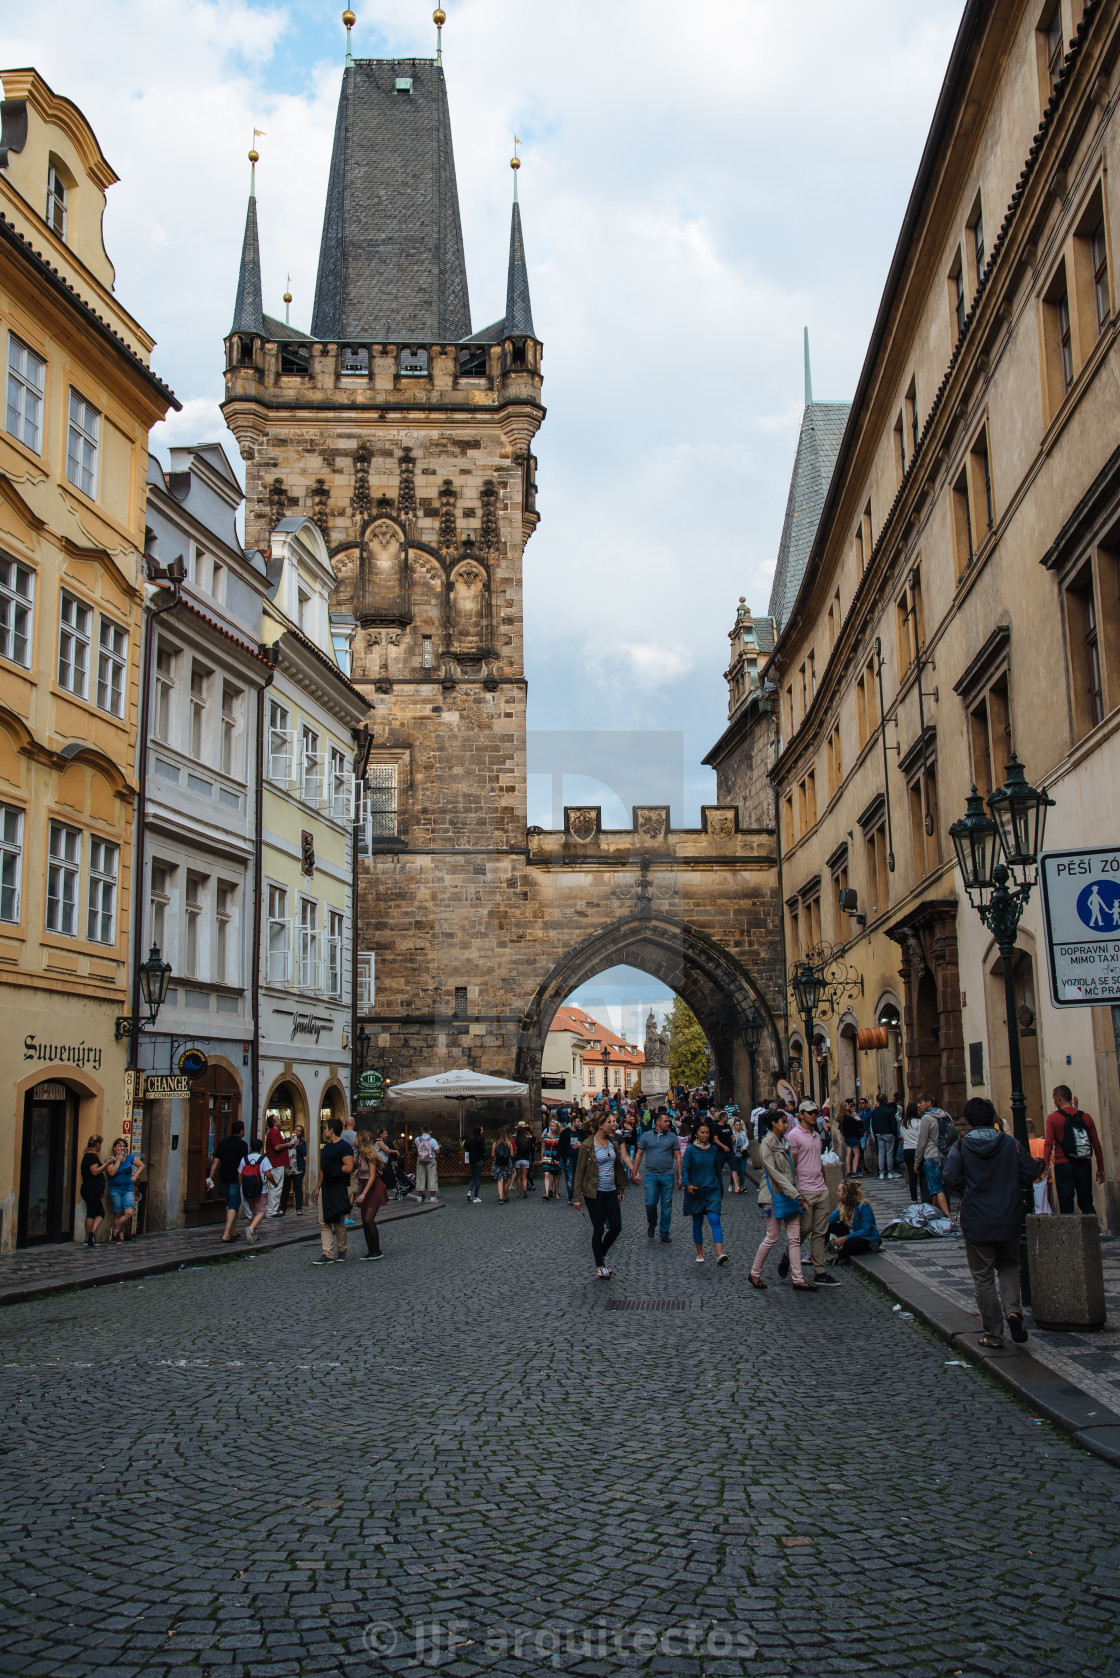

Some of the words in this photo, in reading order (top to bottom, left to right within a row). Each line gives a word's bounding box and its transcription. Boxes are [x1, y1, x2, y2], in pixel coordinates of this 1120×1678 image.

[1056, 858, 1092, 877] PĚŠÍ
[1100, 856, 1120, 873] ZÓ
[1060, 943, 1109, 956] DOPRAVNÍ
[1070, 955, 1095, 965] MIMO
[1097, 953, 1119, 963] TAXI
[1061, 977, 1097, 987] VOZIDLA
[1098, 976, 1109, 985] SE
[1084, 986, 1099, 996] MČ
[24, 1034, 102, 1070] Suvenýry
[126, 1072, 133, 1085] NO
[147, 1075, 188, 1092] CHANGE
